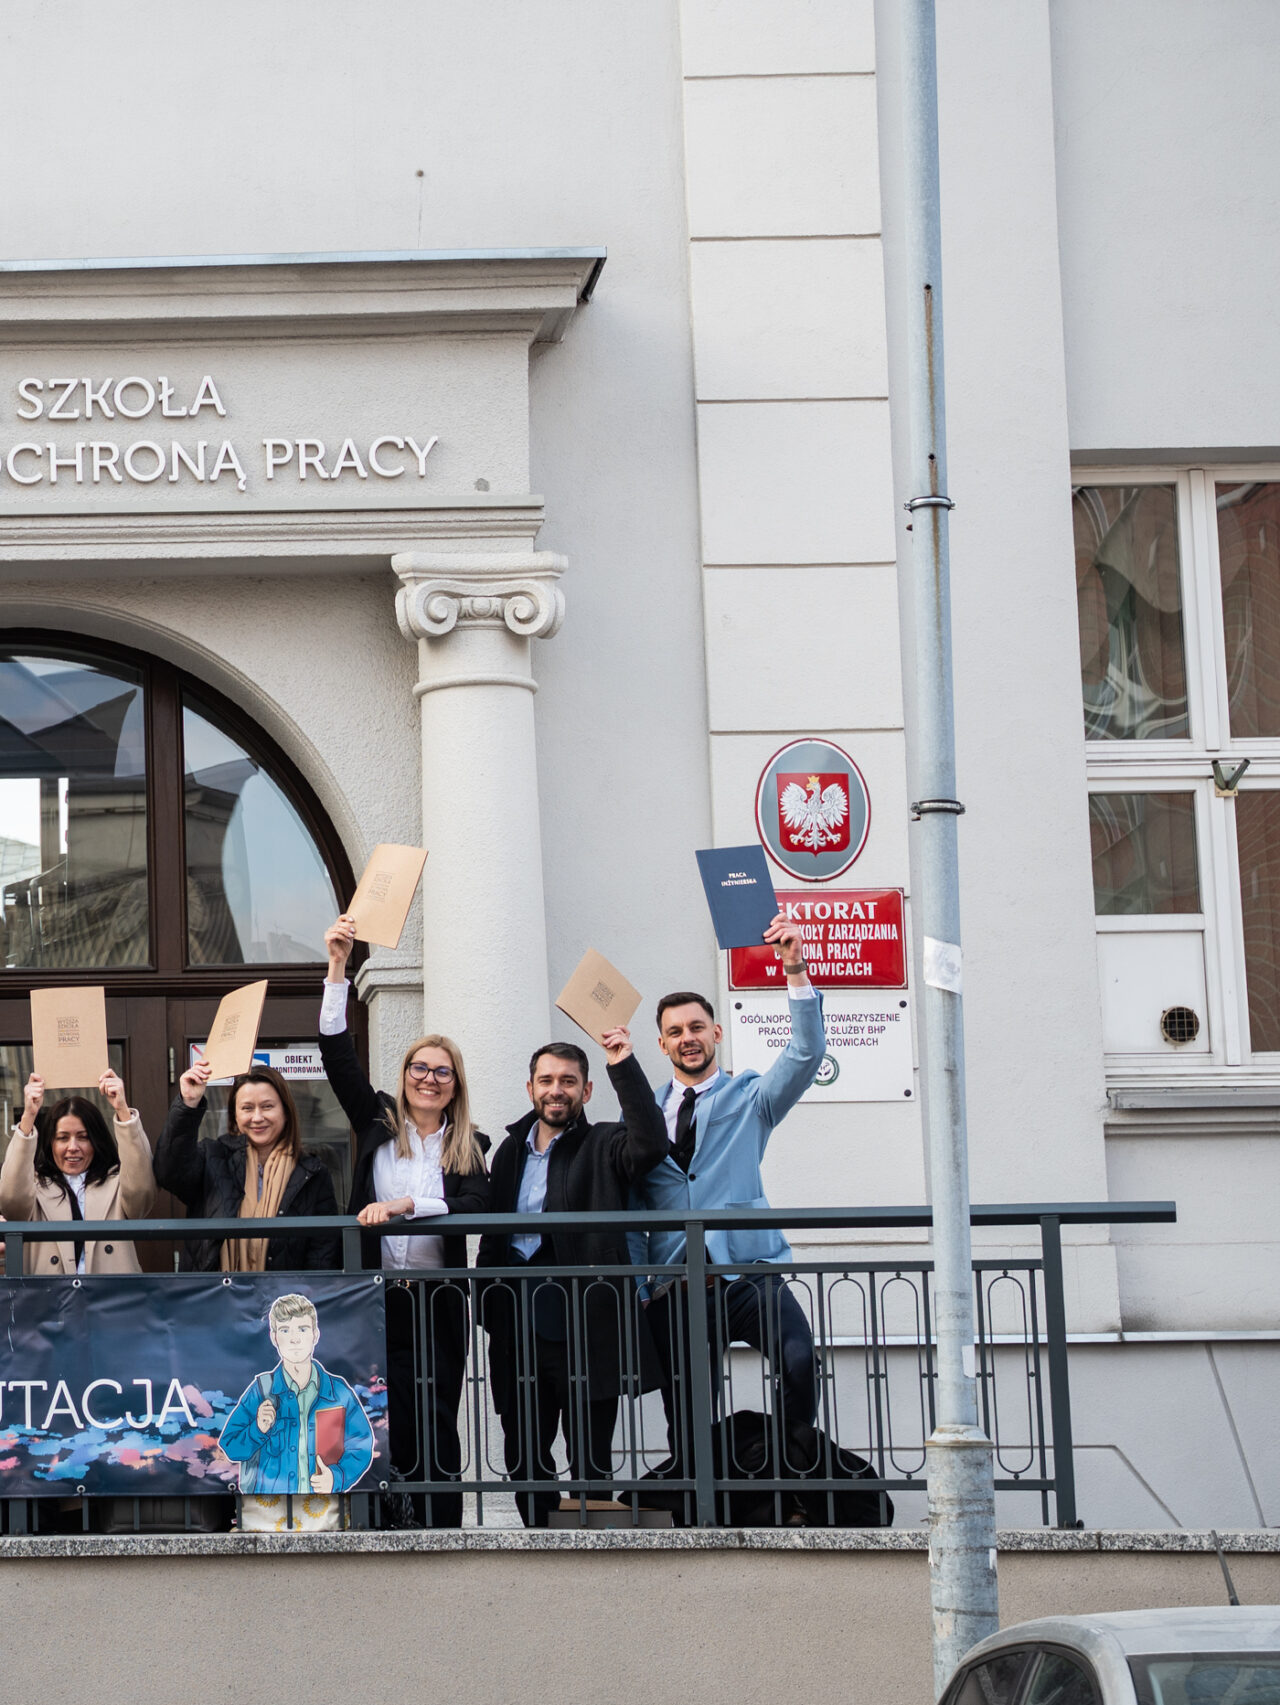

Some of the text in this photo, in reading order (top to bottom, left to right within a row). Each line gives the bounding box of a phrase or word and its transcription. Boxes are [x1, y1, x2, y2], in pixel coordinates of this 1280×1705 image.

[16, 374, 227, 420] SZKOŁA
[262, 435, 439, 481] PRACY
[828, 923, 898, 942] ZARZĄDZANIA
[827, 943, 862, 960] PRACY
[830, 1024, 864, 1035] SŁUŻBY
[867, 1025, 886, 1034] BHP
[284, 1055, 313, 1064] OBIEKT
